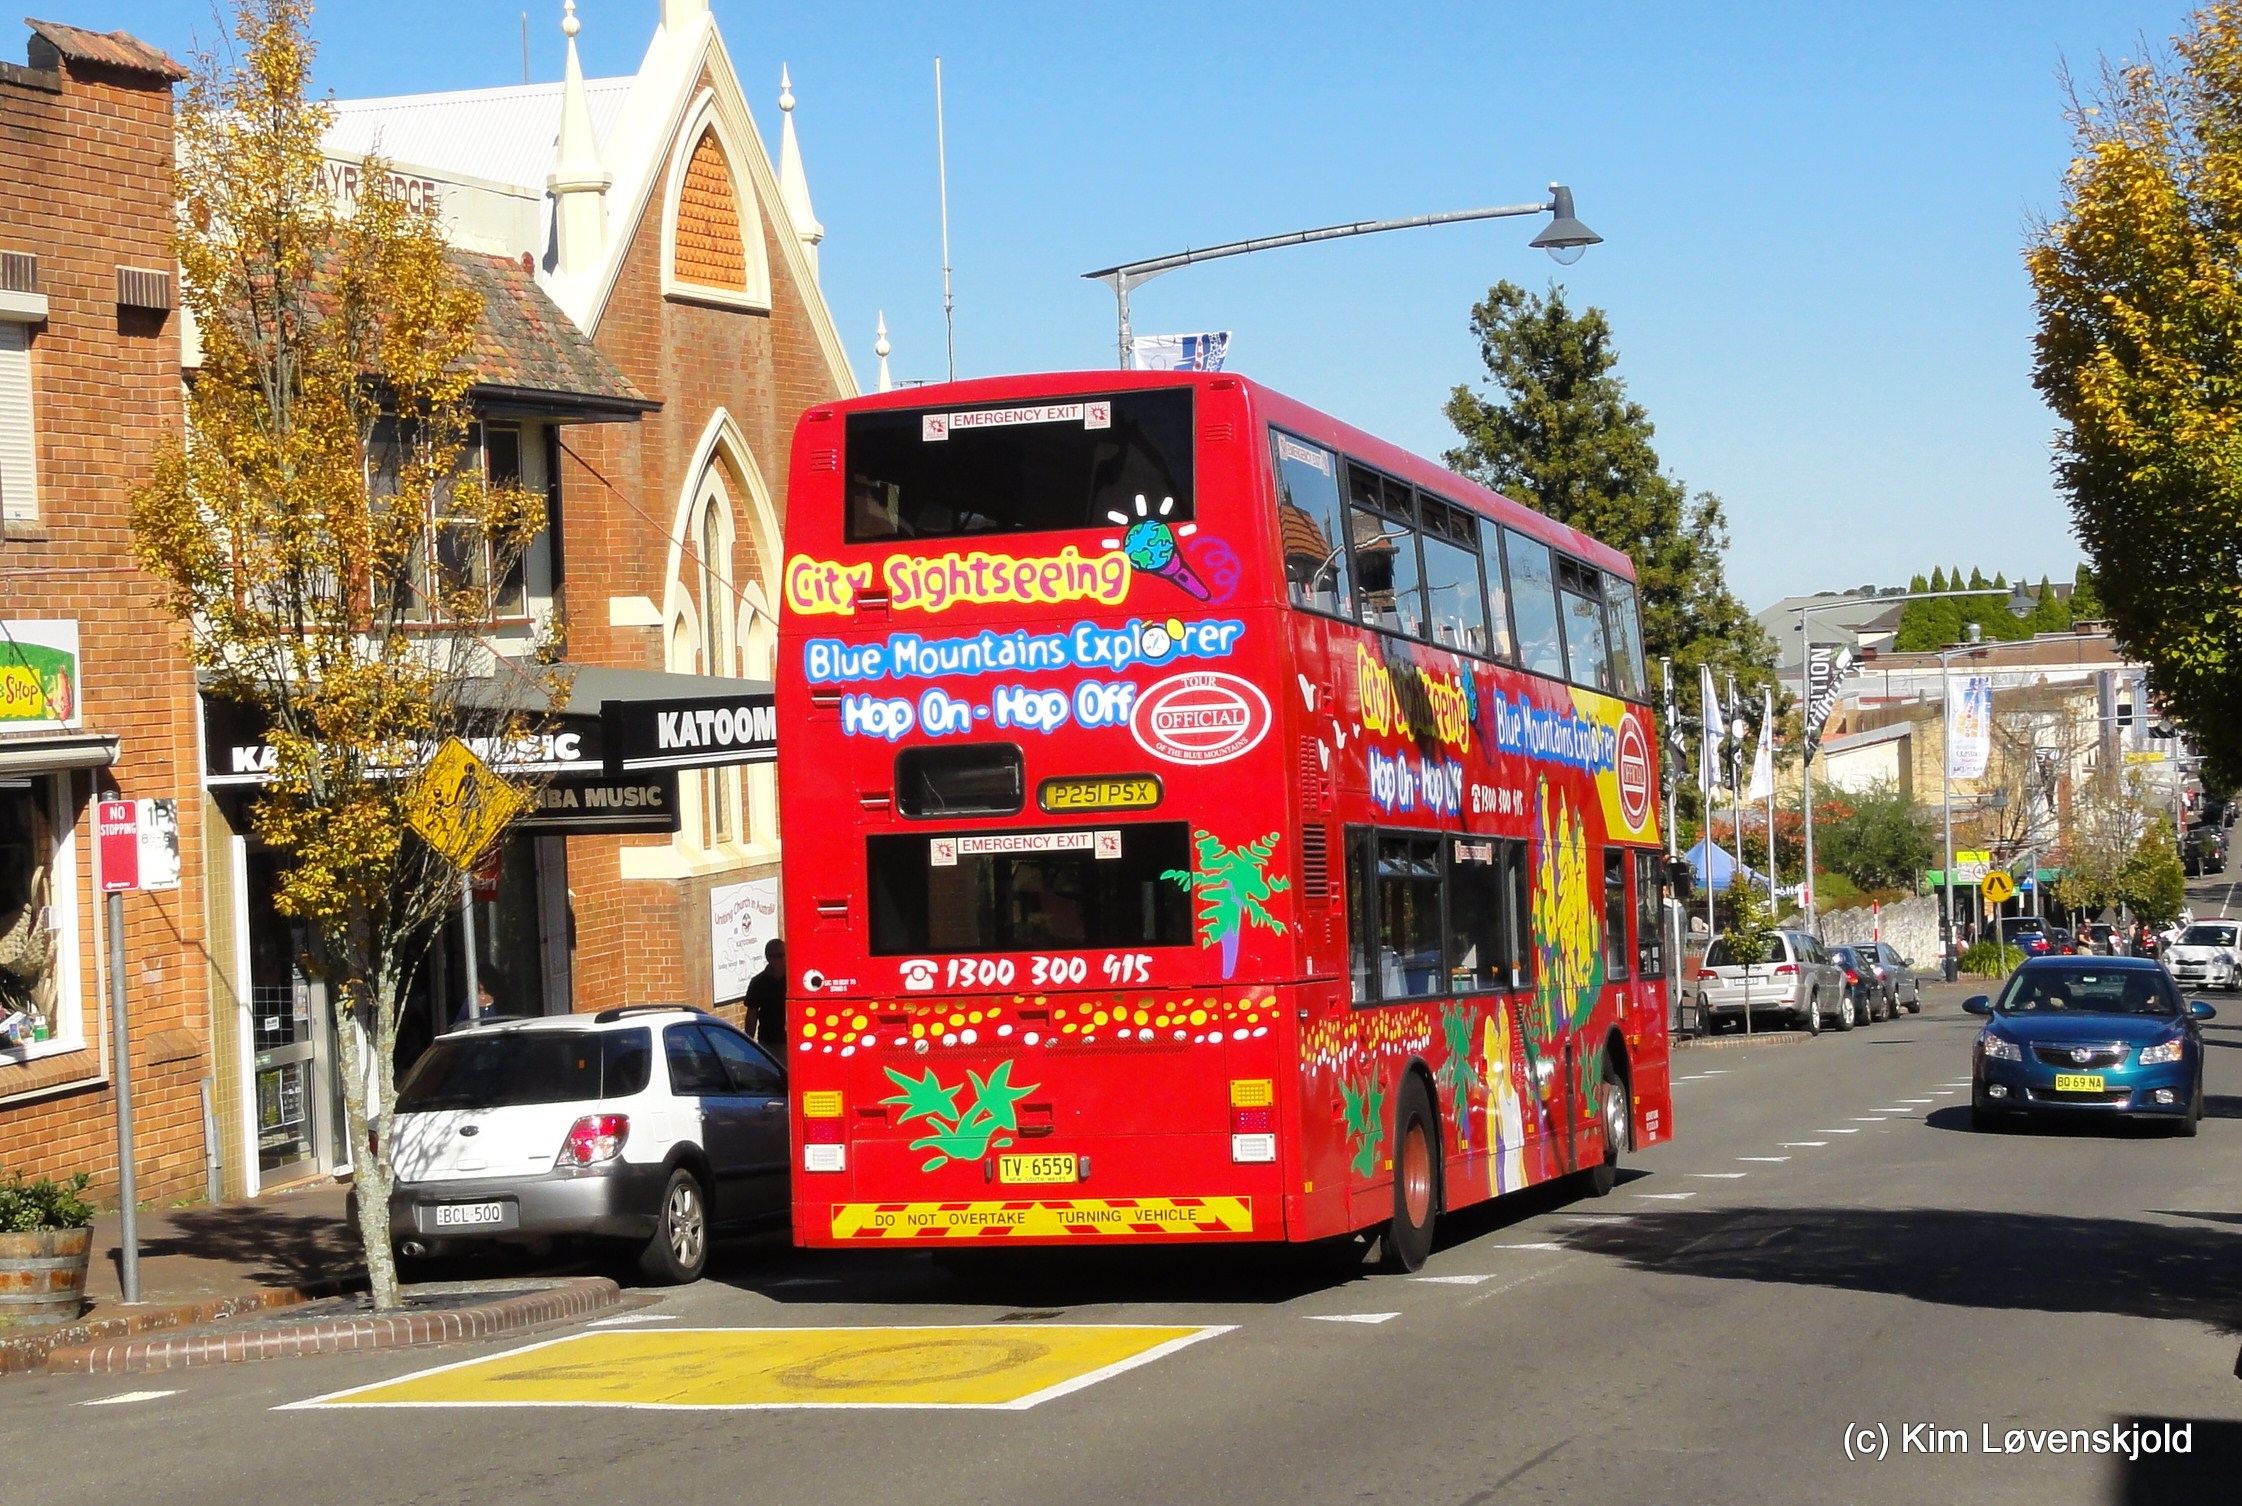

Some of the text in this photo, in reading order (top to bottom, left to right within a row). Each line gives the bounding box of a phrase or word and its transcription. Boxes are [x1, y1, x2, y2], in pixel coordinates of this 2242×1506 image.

[954, 405, 1079, 427] EMERGENCY EXIT
[792, 550, 1125, 608] City Sightseeing
[811, 620, 1238, 678] Blue Mountains Explorer
[1181, 676, 1217, 688] TOUR
[844, 697, 912, 735] Hop
[922, 692, 969, 730] On
[998, 689, 1068, 730] Hop
[1078, 682, 1132, 724] Off
[1159, 709, 1244, 729] OFFICIAL
[1496, 697, 1521, 747] Blue
[1522, 704, 1573, 759] Mountains
[1156, 736, 1249, 759] OF THE BLUE MOUNTAINS
[1370, 751, 1396, 811] Hop
[1399, 755, 1414, 806] On
[1422, 757, 1442, 813] Hop
[1445, 761, 1462, 810] Off
[585, 786, 662, 807] MUSIC
[1055, 783, 1147, 803] P251 PSX
[109, 806, 126, 820] NO
[147, 805, 169, 826] 1P
[100, 823, 137, 836] STOPPING
[963, 834, 1088, 851] EMERGENCY EXIT
[947, 958, 1015, 988] 1300
[1031, 956, 1087, 986] 300
[2073, 1077, 2086, 1087] 69
[2089, 1077, 2102, 1088] NA
[1032, 1158, 1073, 1176] 6559
[444, 1208, 469, 1223] BCL
[875, 1208, 1198, 1227] DO NOT OVERTAKE TURNING VEHICLE
